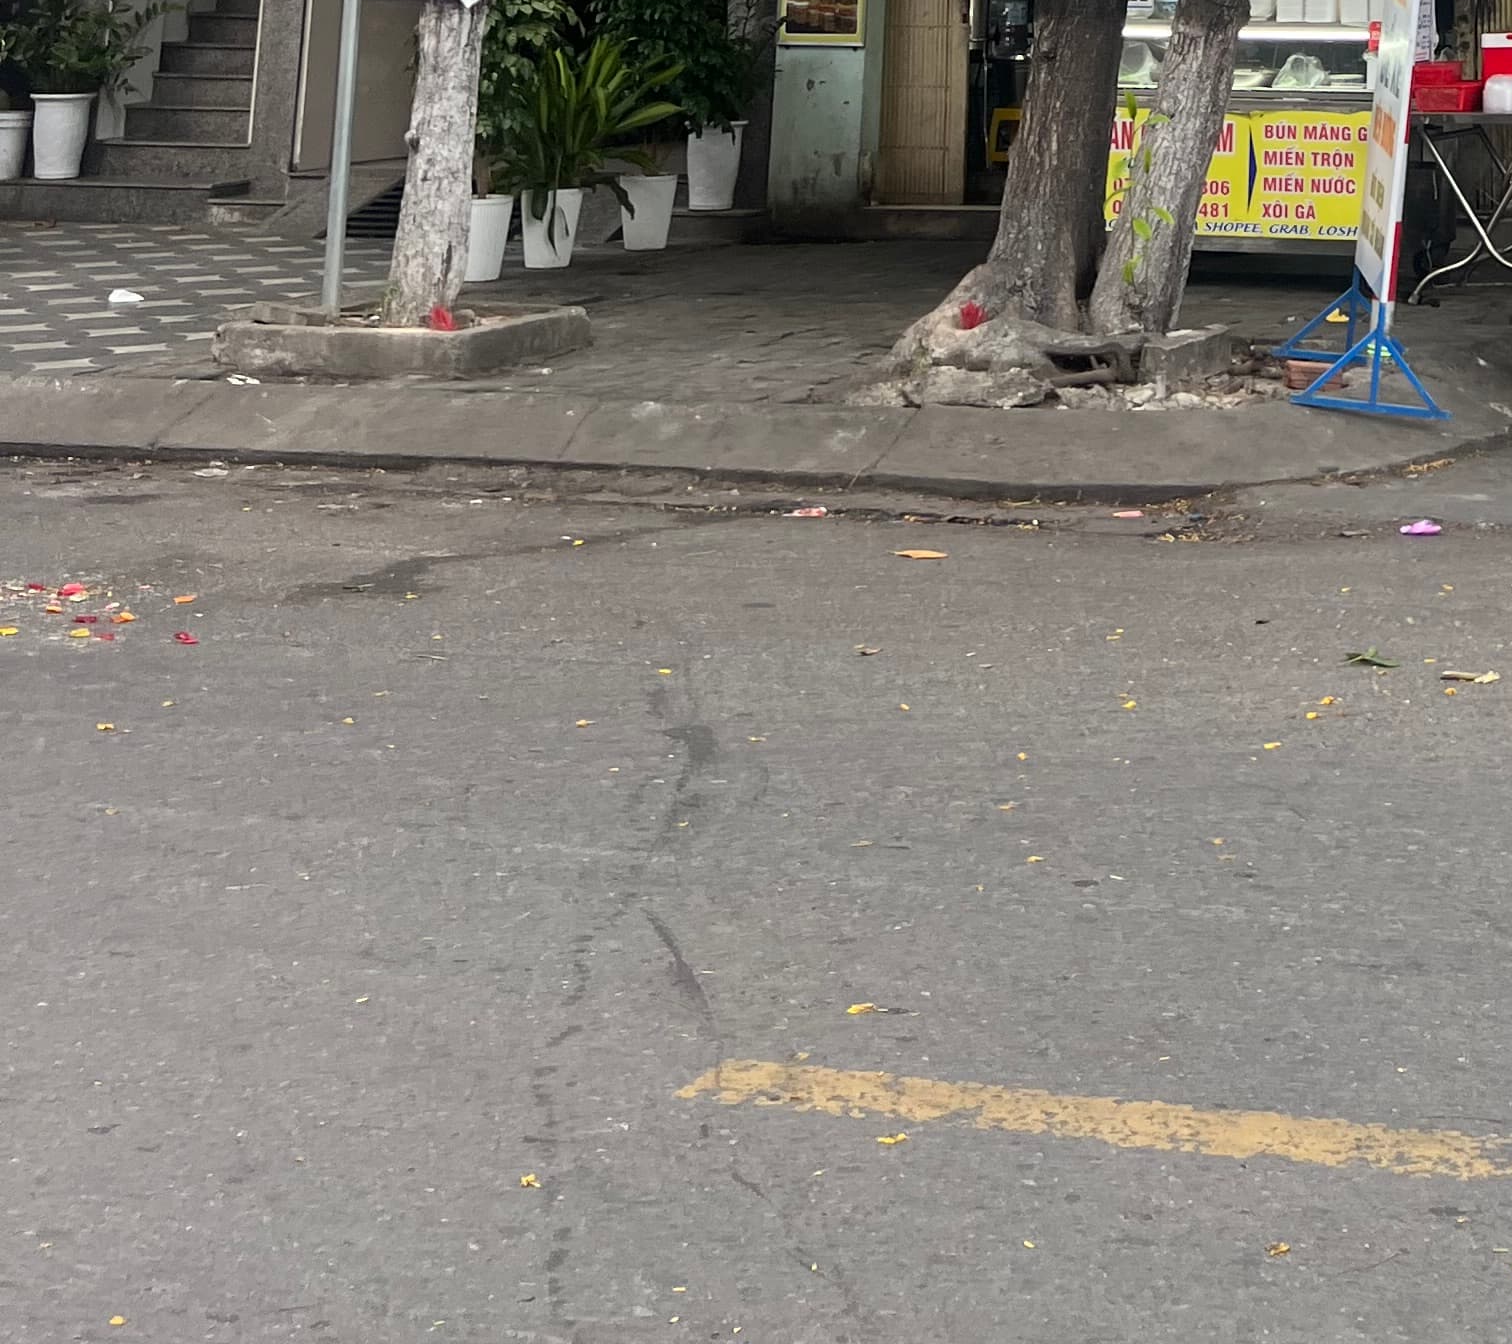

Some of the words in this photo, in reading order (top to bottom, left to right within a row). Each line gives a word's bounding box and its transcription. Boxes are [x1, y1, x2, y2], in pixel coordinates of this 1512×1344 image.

[1264, 120, 1297, 140] BÚN
[1304, 122, 1351, 141] MĂNG
[1264, 147, 1304, 167] MIẾN
[1311, 148, 1354, 170] TRỘN
[1264, 173, 1304, 193] MIẾN
[1311, 173, 1356, 194] NƯỚC
[1262, 202, 1288, 219] XÔI
[1295, 202, 1316, 220] GÀ
[1318, 224, 1359, 237] LOSH
